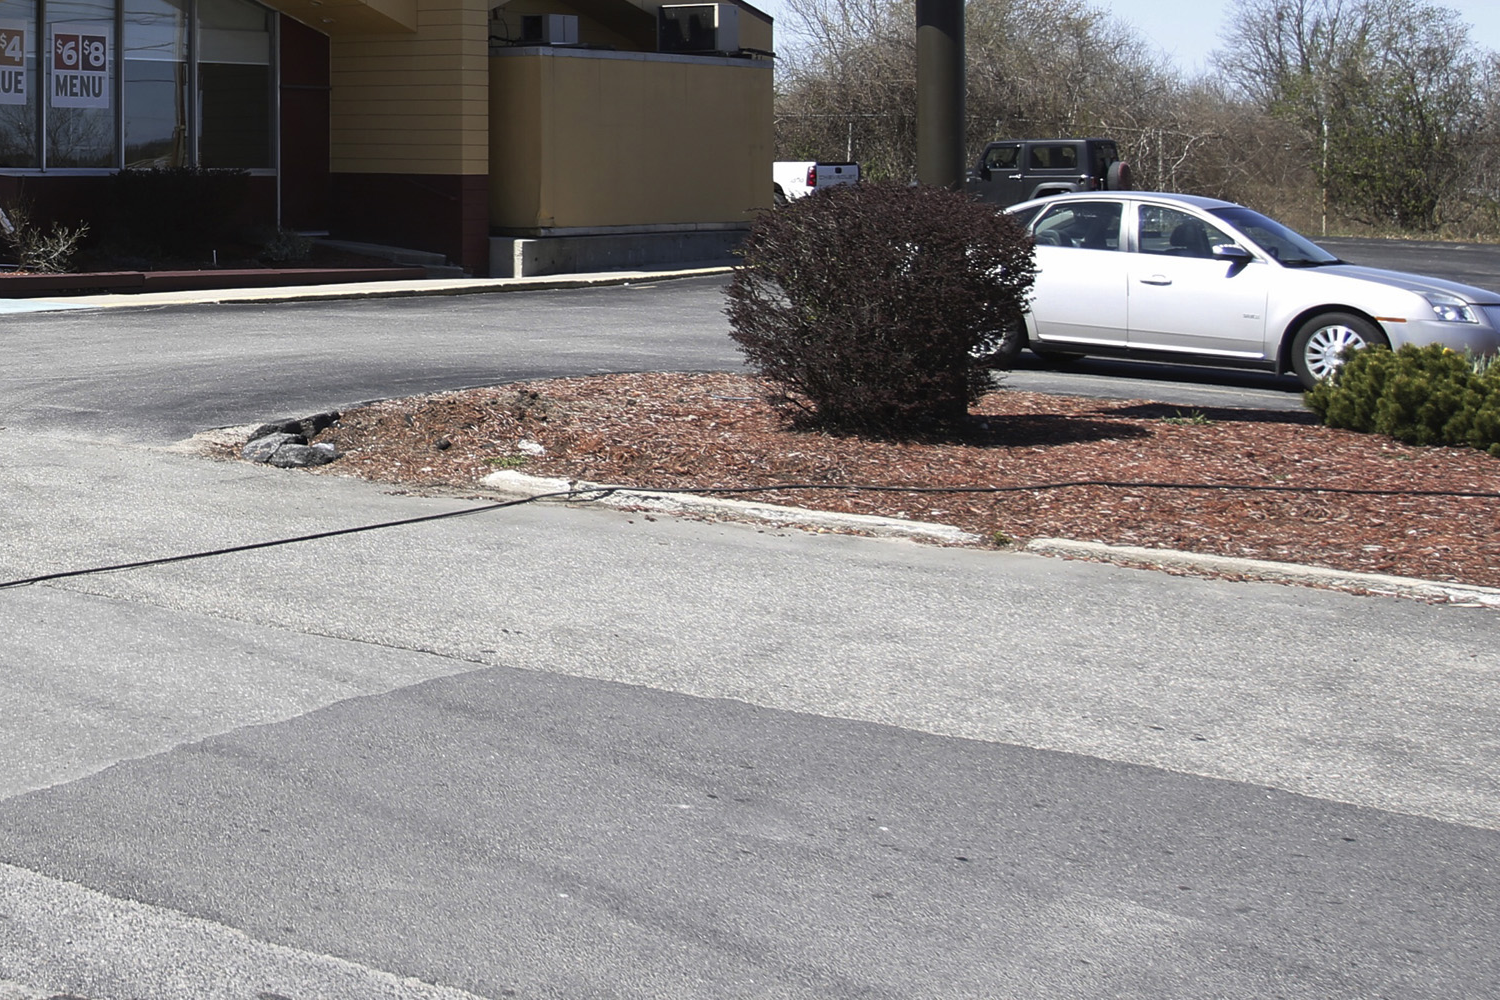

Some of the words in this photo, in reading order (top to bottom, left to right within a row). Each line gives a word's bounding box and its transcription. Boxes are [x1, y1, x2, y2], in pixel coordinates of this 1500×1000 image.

[0, 33, 23, 62] $4
[56, 39, 78, 66] $6
[83, 39, 105, 68] $8
[55, 74, 103, 98] MENU
